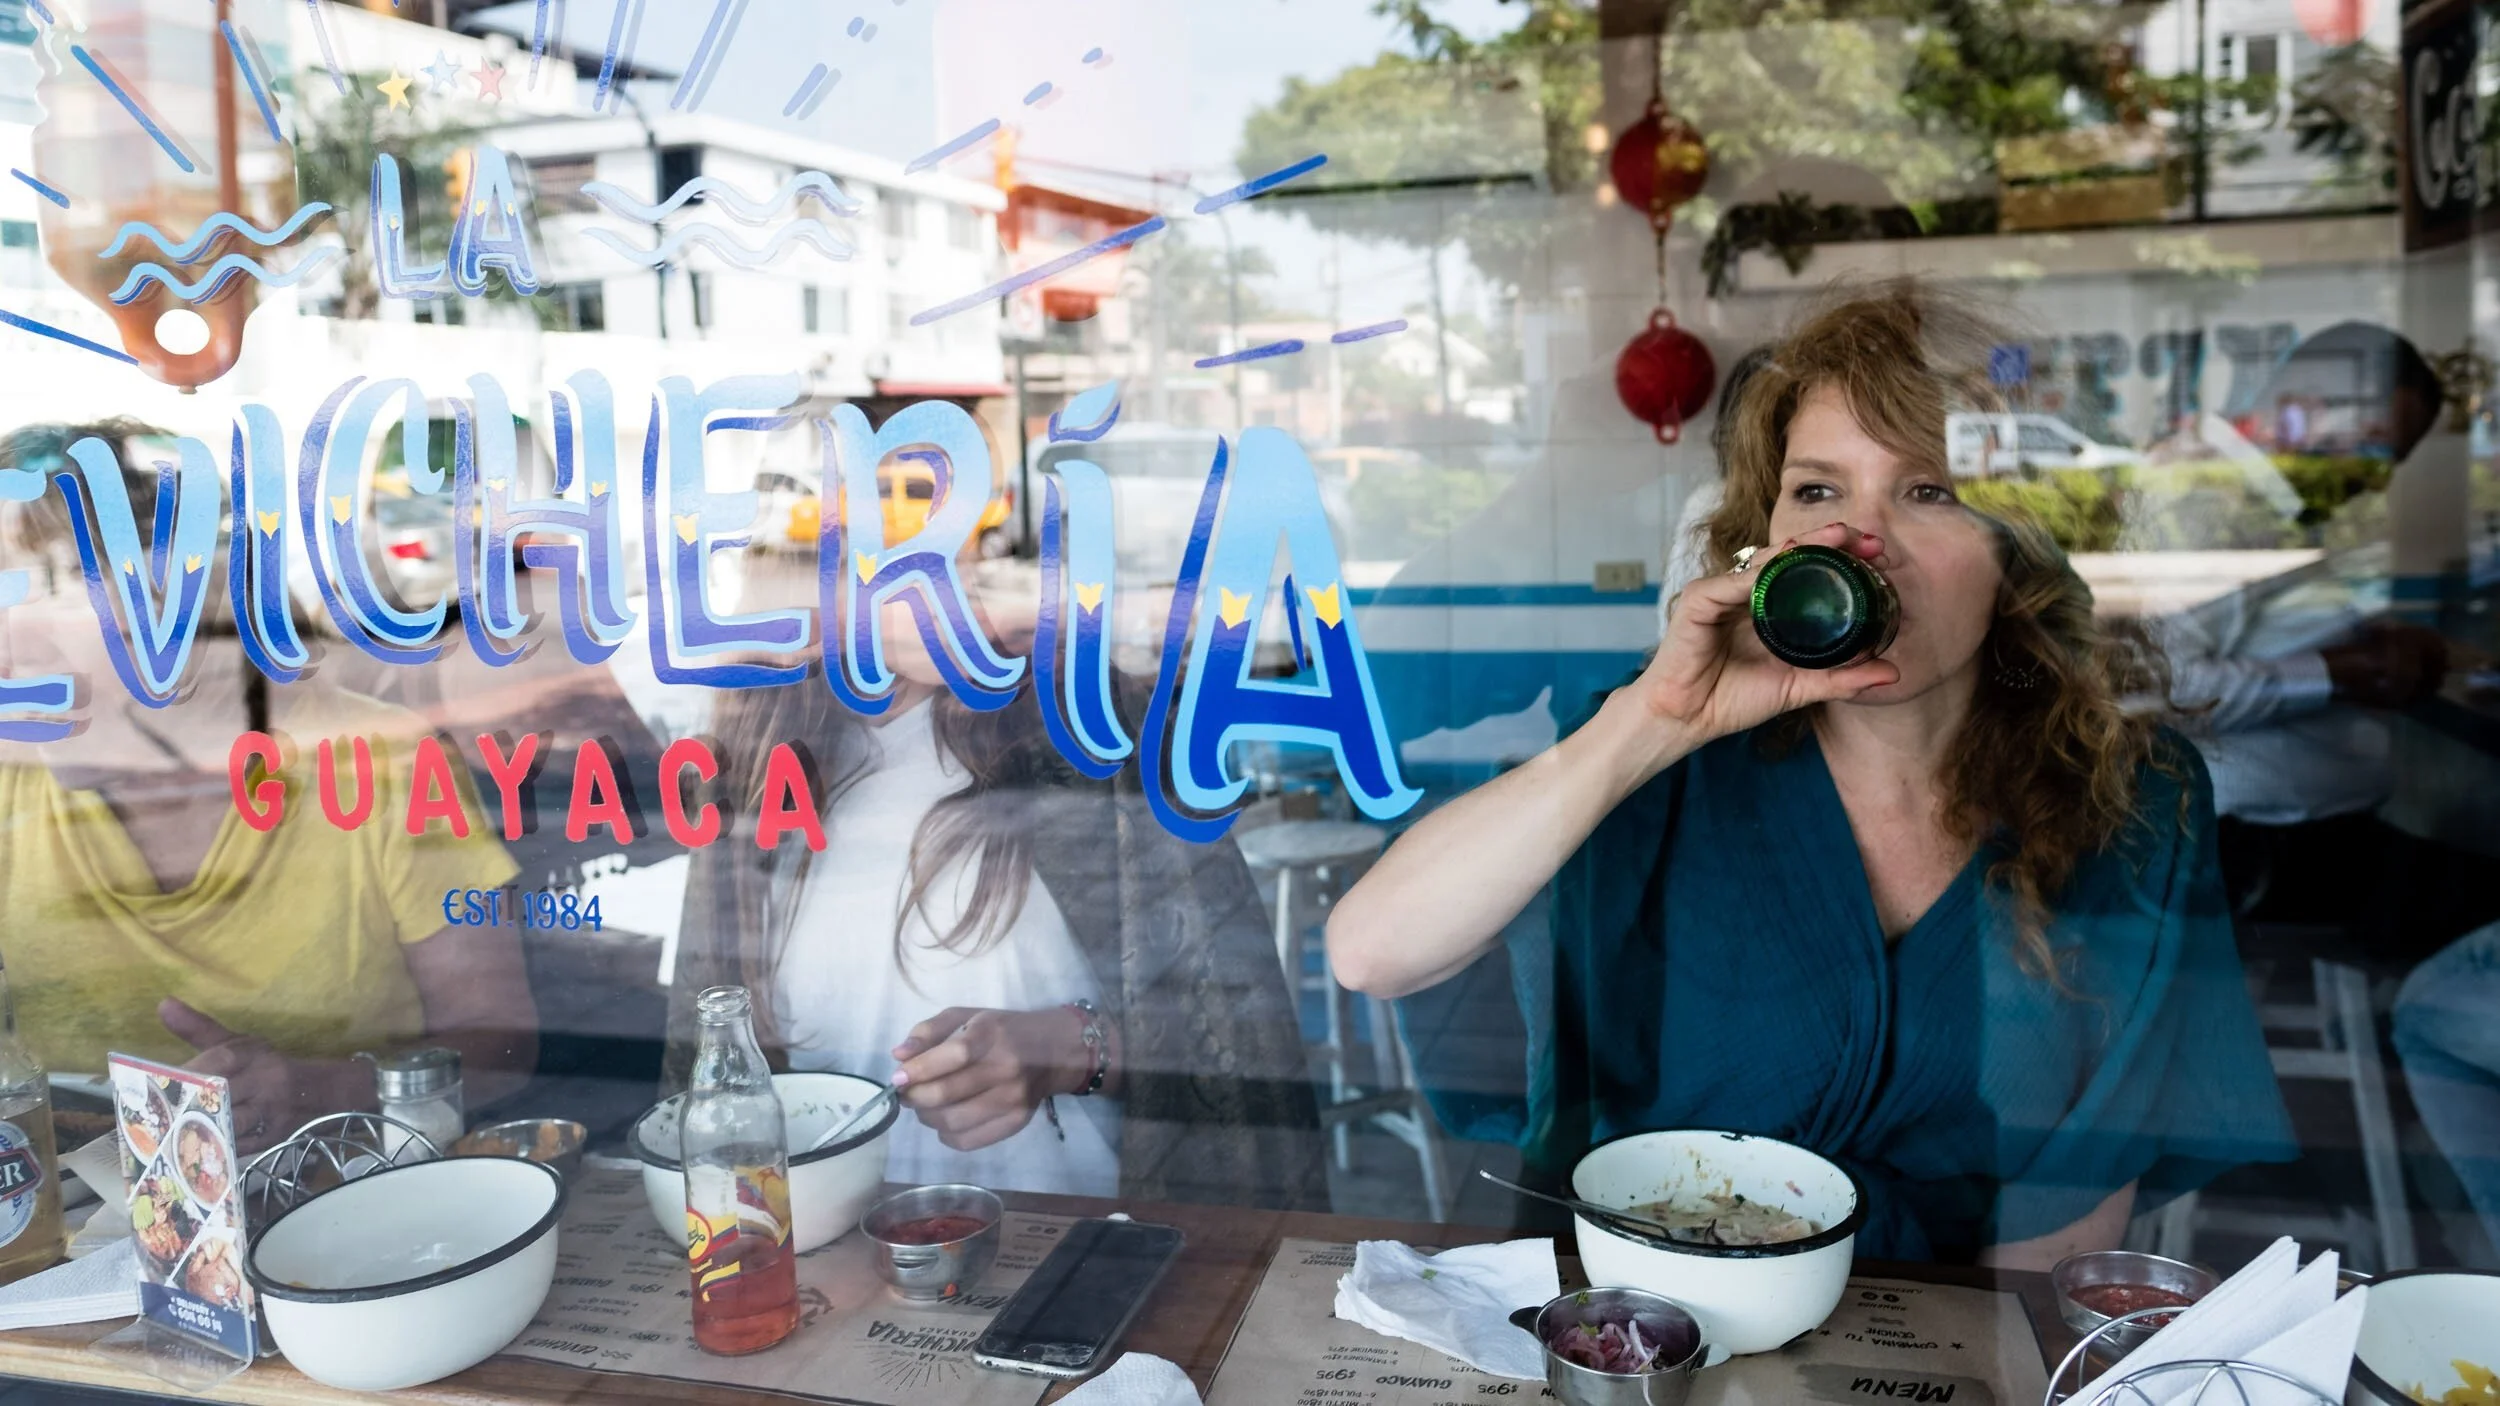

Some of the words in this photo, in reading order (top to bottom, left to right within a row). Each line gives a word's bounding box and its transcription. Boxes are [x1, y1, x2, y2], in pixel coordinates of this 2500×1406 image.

[371, 145, 541, 299] LA
[228, 730, 828, 853] GUAYACA
[522, 891, 603, 933] 1984
[1844, 1333, 1864, 1344] TU
[1864, 1327, 1916, 1340] CEVICHE
[1871, 1338, 1939, 1351] COMBINA
[918, 1352, 937, 1362] LA
[1315, 1369, 1357, 1381] $995
[1375, 1375, 1453, 1390] GUAYACO
[1477, 1383, 1520, 1396] $995
[1850, 1377, 1956, 1404] MENU
